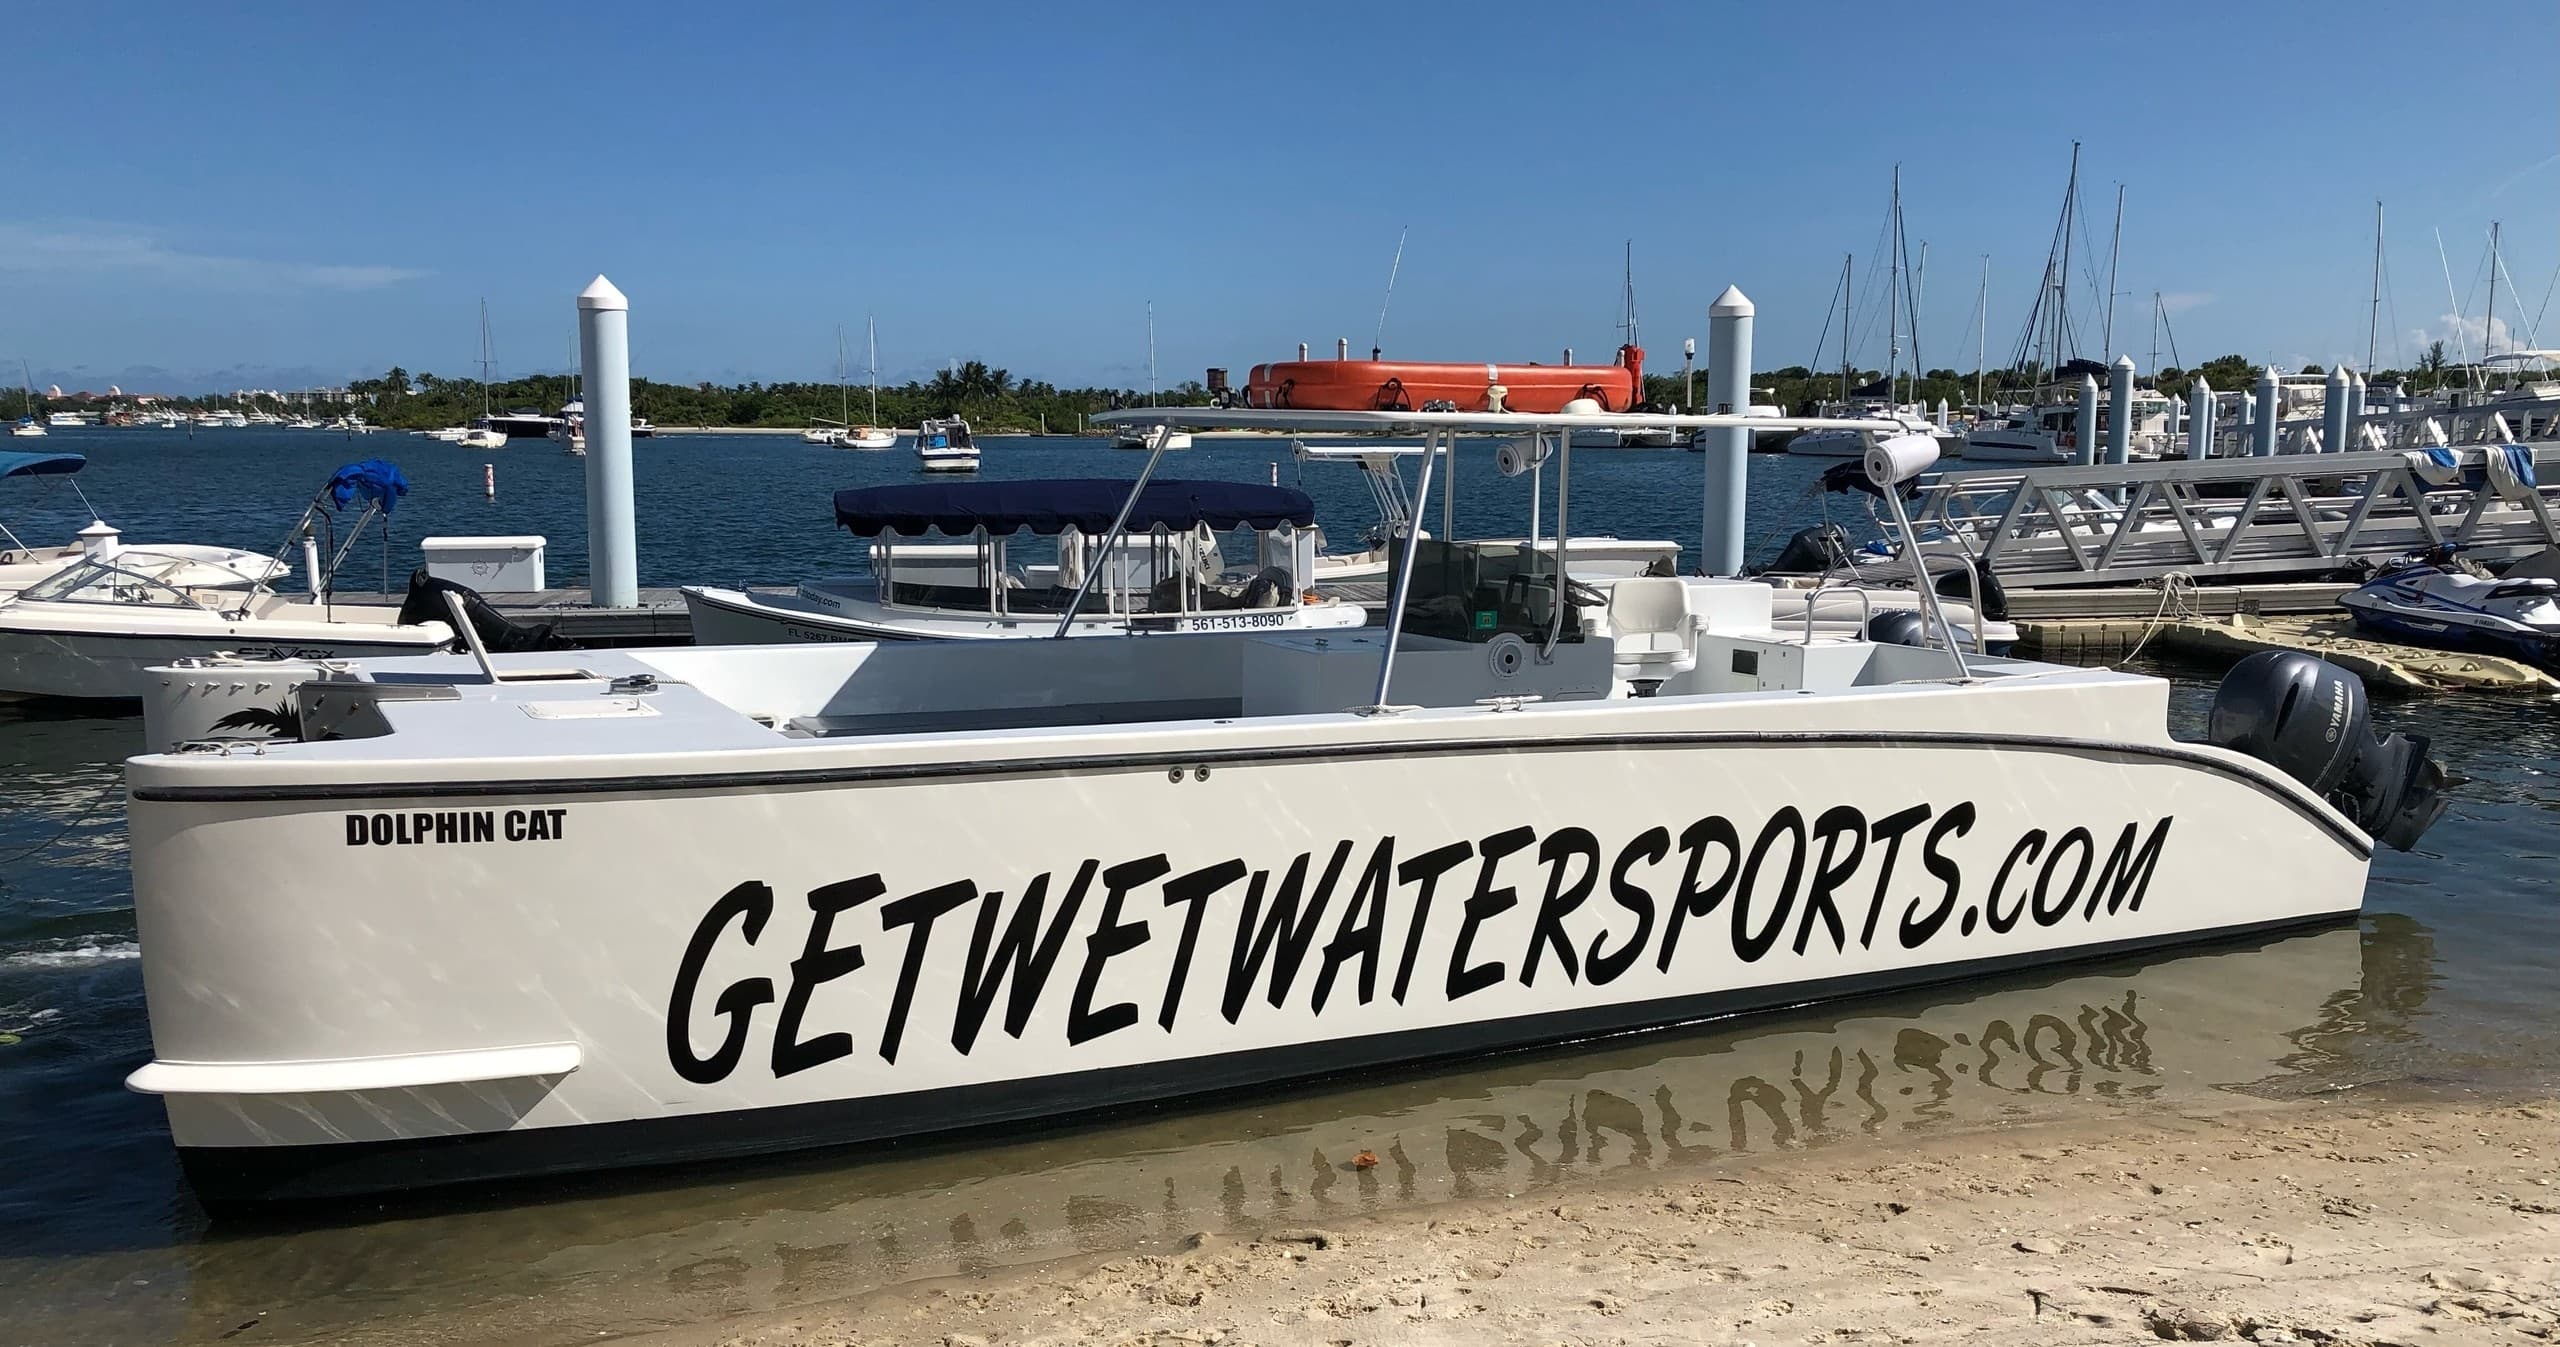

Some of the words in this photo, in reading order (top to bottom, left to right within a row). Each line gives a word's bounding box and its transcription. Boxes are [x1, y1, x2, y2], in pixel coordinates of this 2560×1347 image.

[788, 627, 801, 639] FL
[804, 630, 827, 642] 5267
[1192, 614, 1284, 632] 561-513-8090
[2329, 679, 2344, 728] YAMAHA
[345, 810, 496, 847] DOLPHIN
[504, 808, 568, 842] CAT
[666, 802, 2174, 1085] GETWETWATERSPORTS.COM
